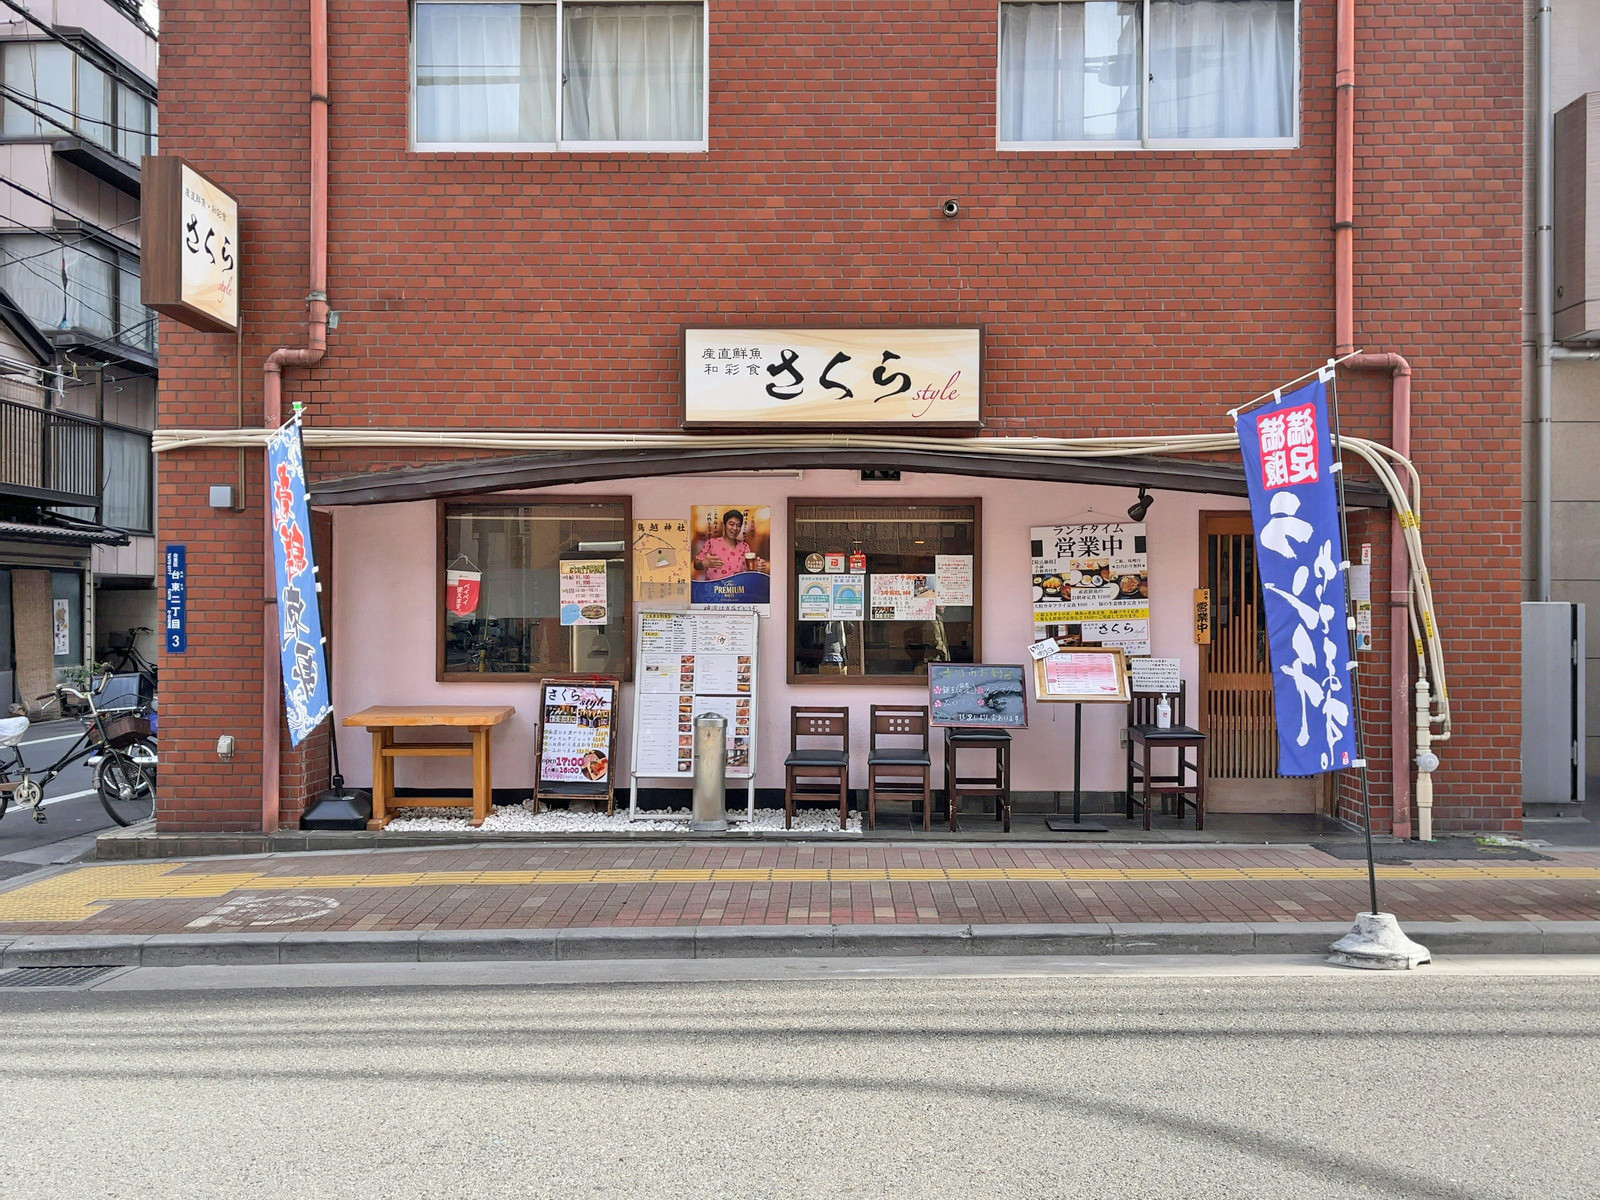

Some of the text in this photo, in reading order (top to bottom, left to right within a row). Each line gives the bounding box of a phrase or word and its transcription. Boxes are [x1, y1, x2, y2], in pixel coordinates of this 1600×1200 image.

[186, 213, 234, 273] さくら
[217, 275, 233, 304] style
[701, 347, 763, 360] 産直鮮魚
[704, 363, 761, 376] 和彩食
[765, 348, 962, 418] さくら style
[636, 523, 686, 532] 鳥越神社
[1053, 523, 1124, 536] ランチタイム
[1054, 535, 1124, 559] 営業中
[714, 585, 745, 594] PREMIUM
[170, 569, 181, 648] 台東二丁目 3
[1196, 601, 1209, 634] 営業中
[1098, 622, 1134, 635] さくら
[547, 688, 580, 702] さくら
[579, 697, 608, 710] style
[556, 756, 585, 767] 17:00
